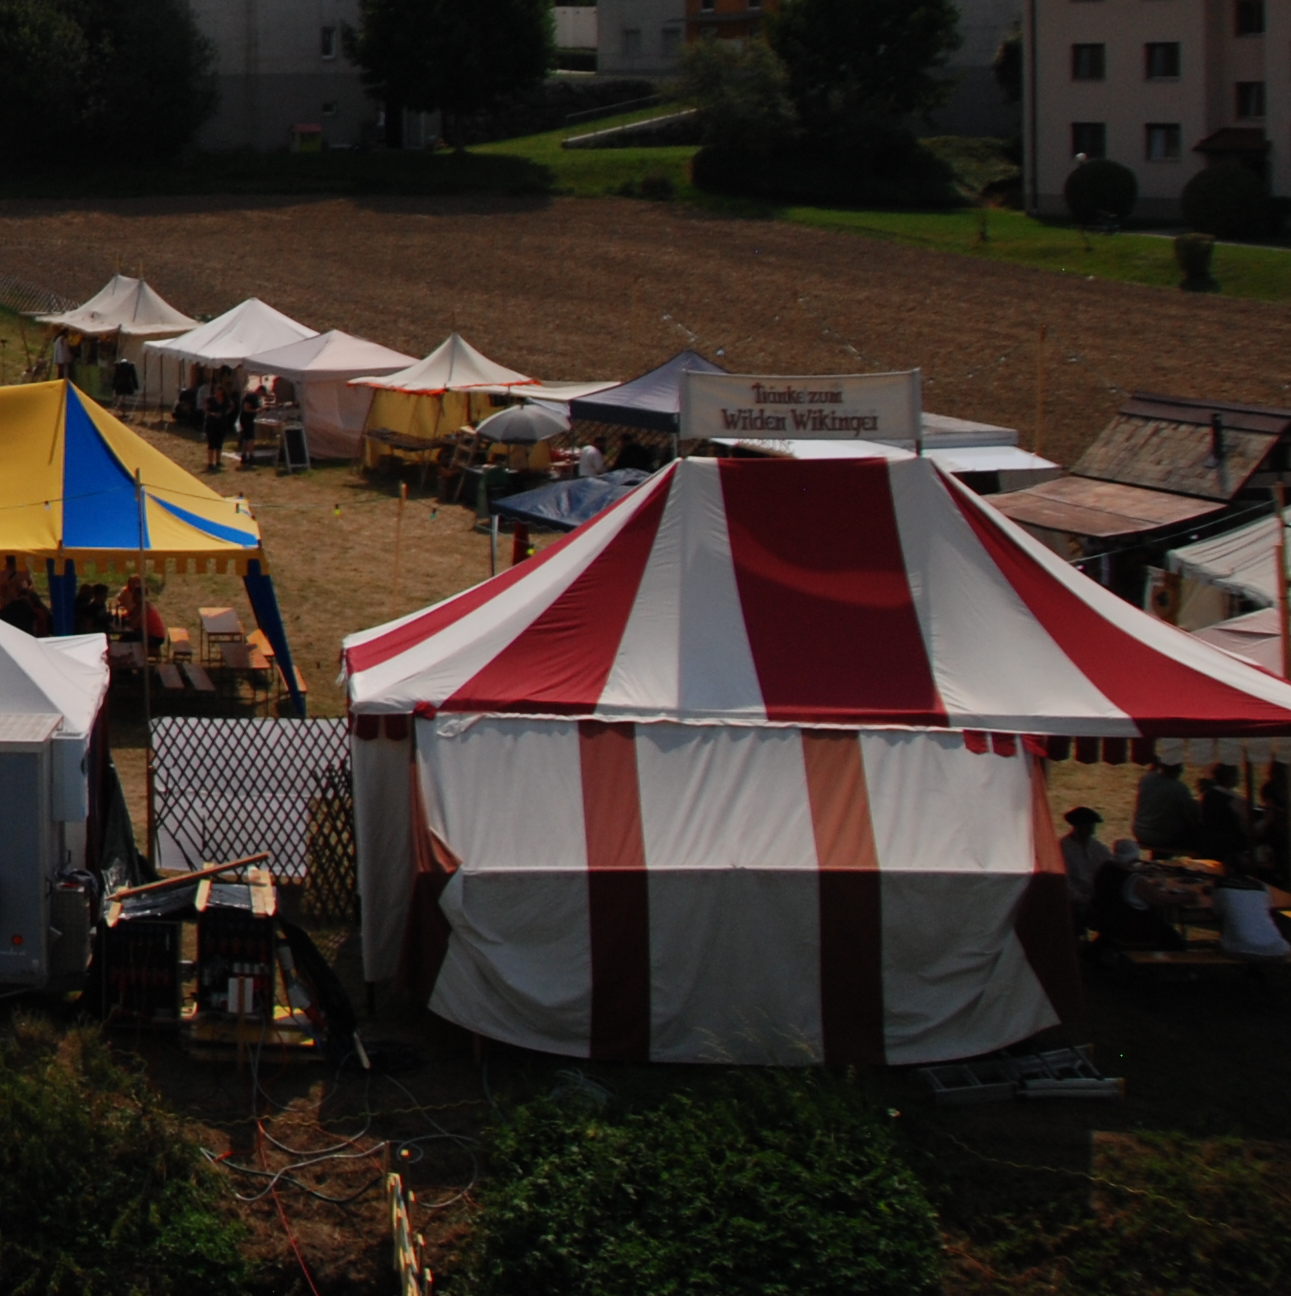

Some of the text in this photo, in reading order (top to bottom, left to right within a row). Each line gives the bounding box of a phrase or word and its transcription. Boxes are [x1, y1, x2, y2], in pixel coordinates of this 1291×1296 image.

[807, 390, 843, 404] zum
[721, 408, 879, 437] Wilden Wikinger
